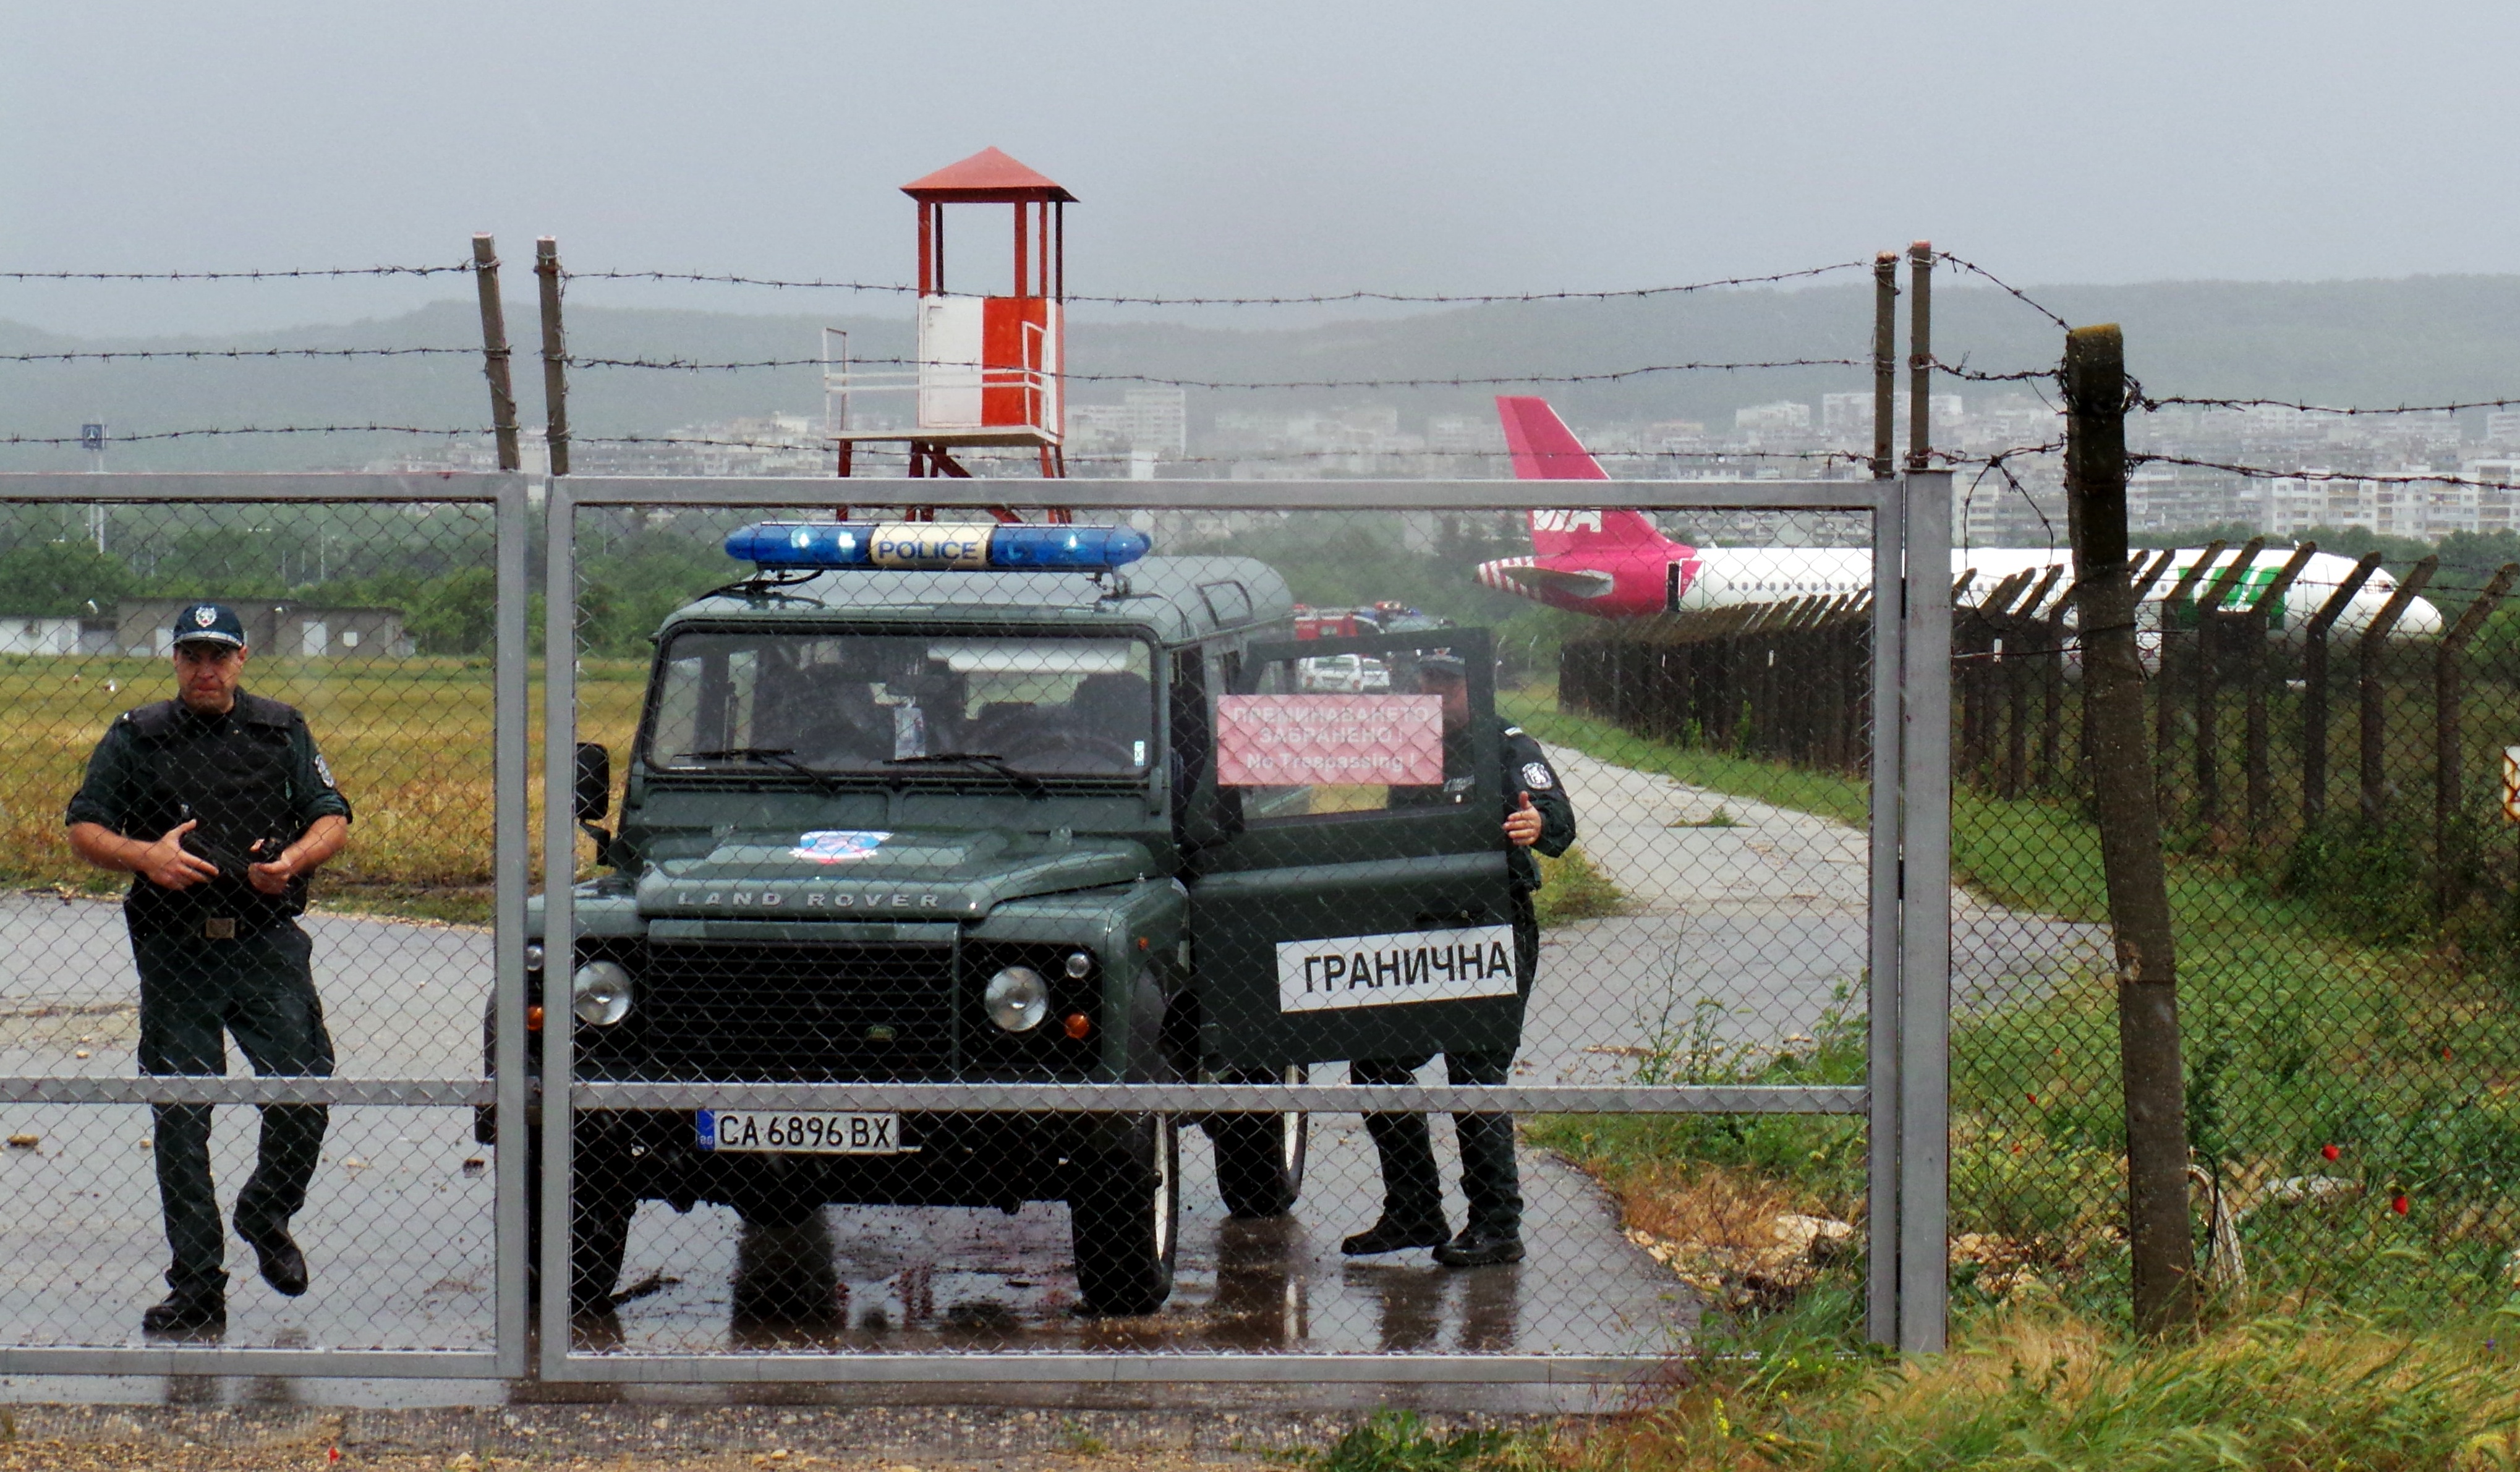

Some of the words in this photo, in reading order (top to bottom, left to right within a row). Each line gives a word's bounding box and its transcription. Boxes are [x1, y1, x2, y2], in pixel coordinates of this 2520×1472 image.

[878, 540, 979, 559] POLICE
[1233, 707, 1429, 723] ПРЕМИНАВАНЕТО
[1259, 728, 1392, 743] ЗАБРАНЕНО
[1246, 752, 1274, 769] No
[1279, 752, 1403, 773] Trespassing
[678, 891, 783, 906] LAND
[807, 893, 939, 908] ROVER
[1304, 940, 1513, 993] ГРАНИЧНА
[767, 1115, 844, 1147] 6896
